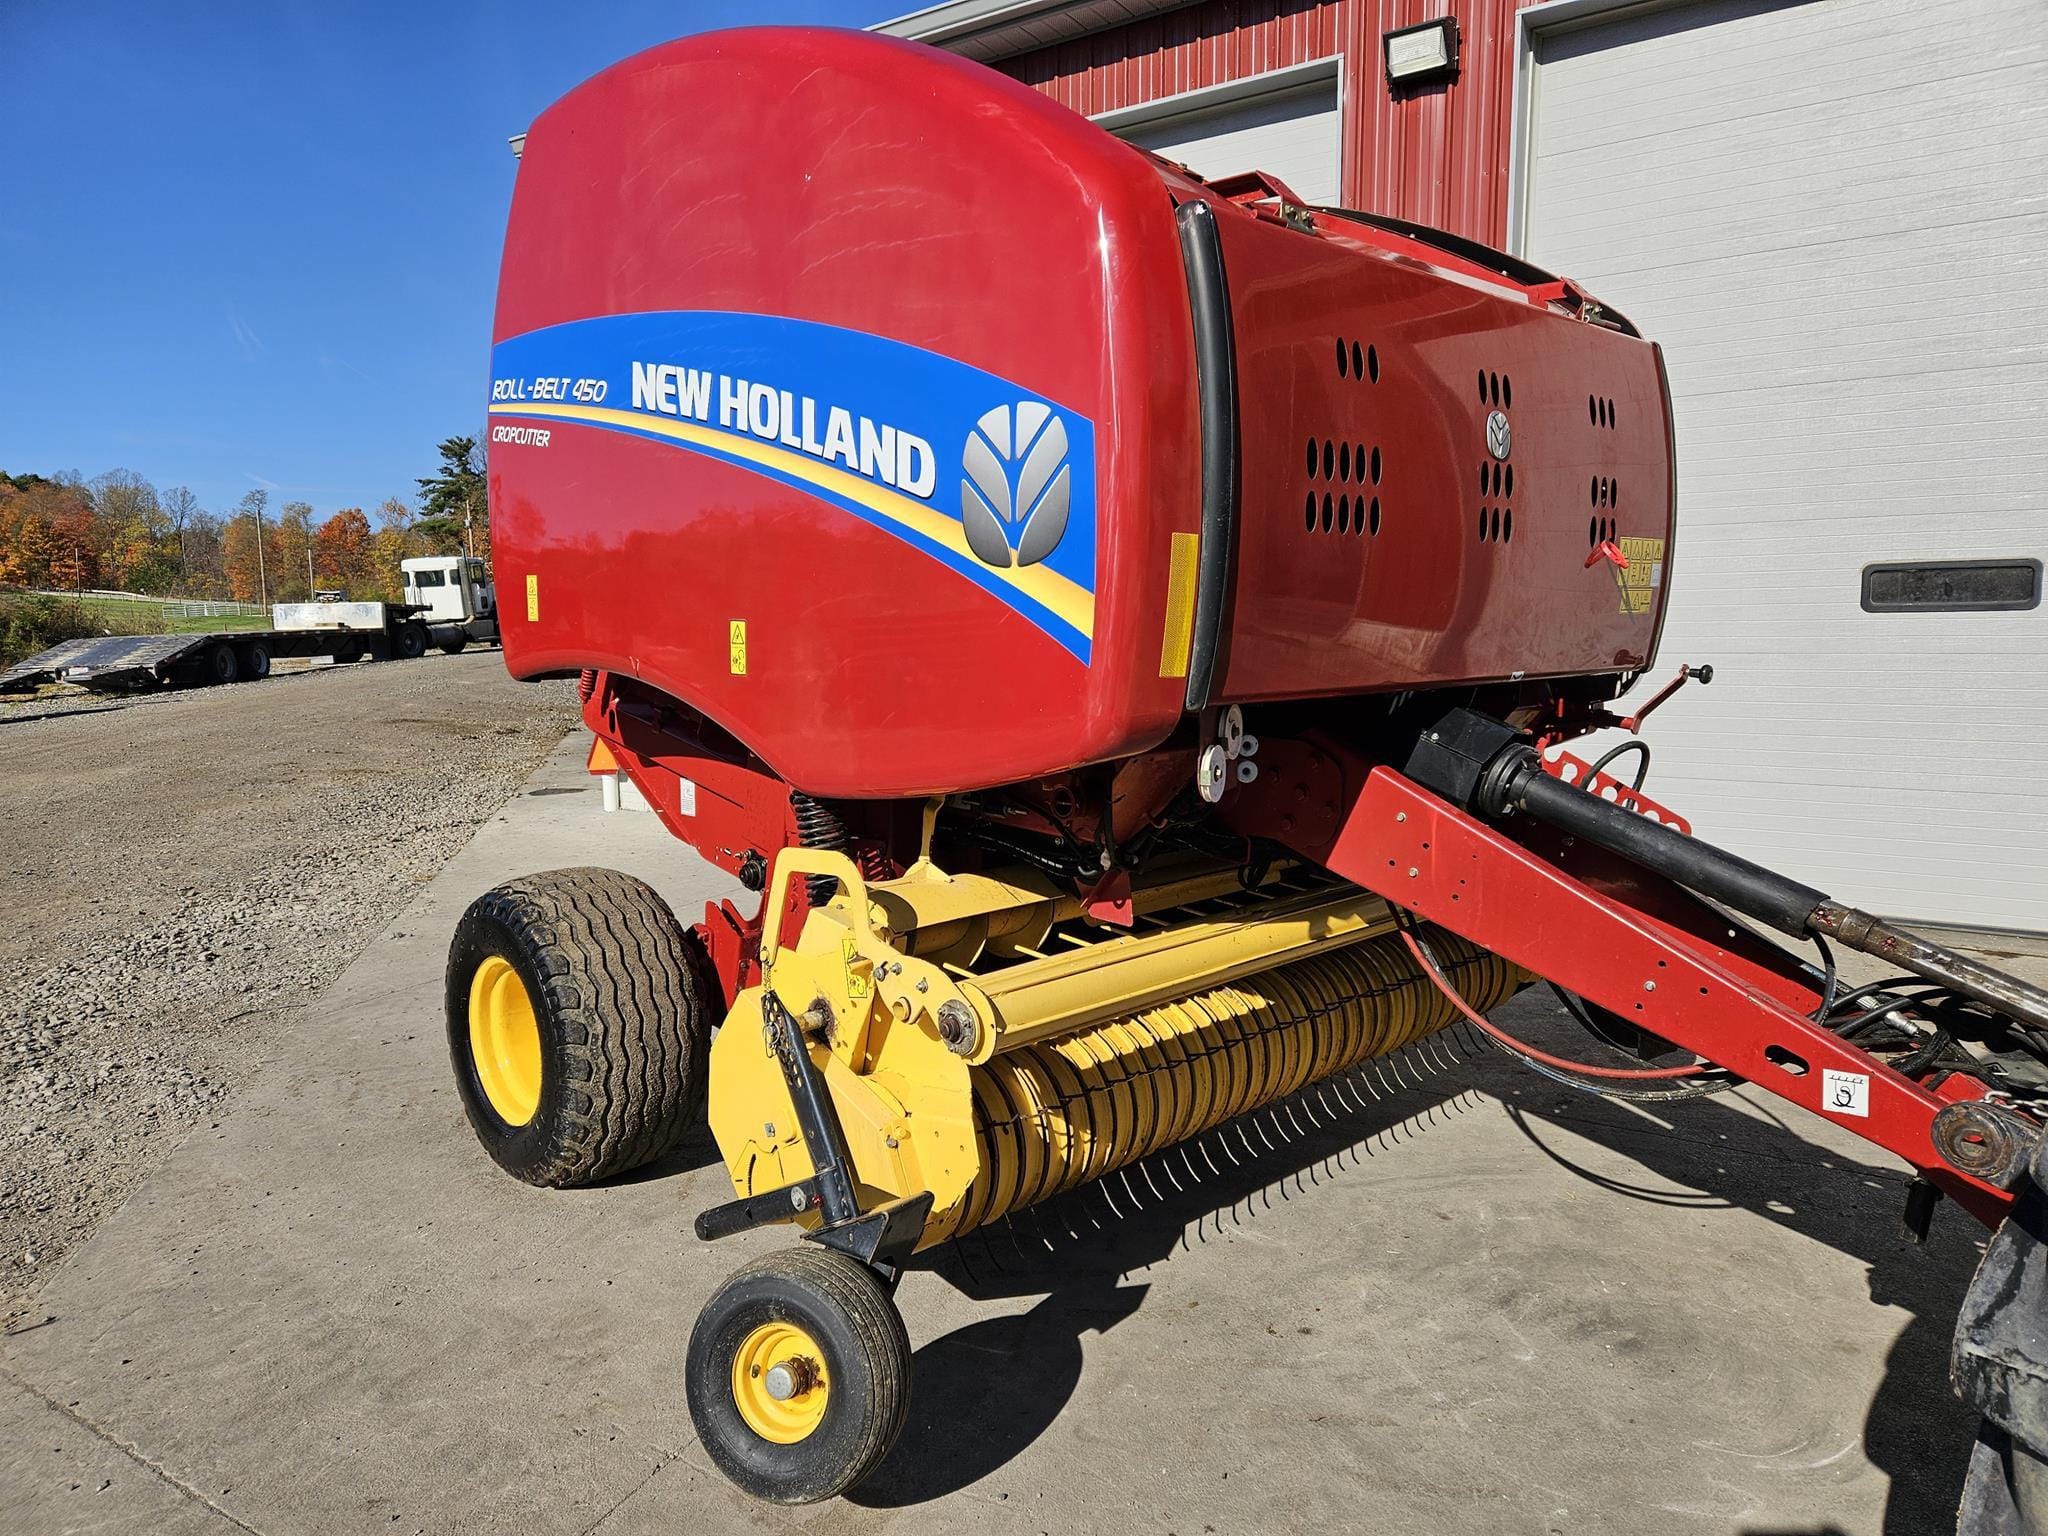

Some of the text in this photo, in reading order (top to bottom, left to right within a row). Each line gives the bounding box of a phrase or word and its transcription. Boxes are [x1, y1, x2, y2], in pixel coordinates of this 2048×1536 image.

[492, 377, 608, 403] ROLL-BELT 450
[492, 426, 550, 447] CROPCUTTER
[631, 361, 936, 499] NEW HOLLAND
